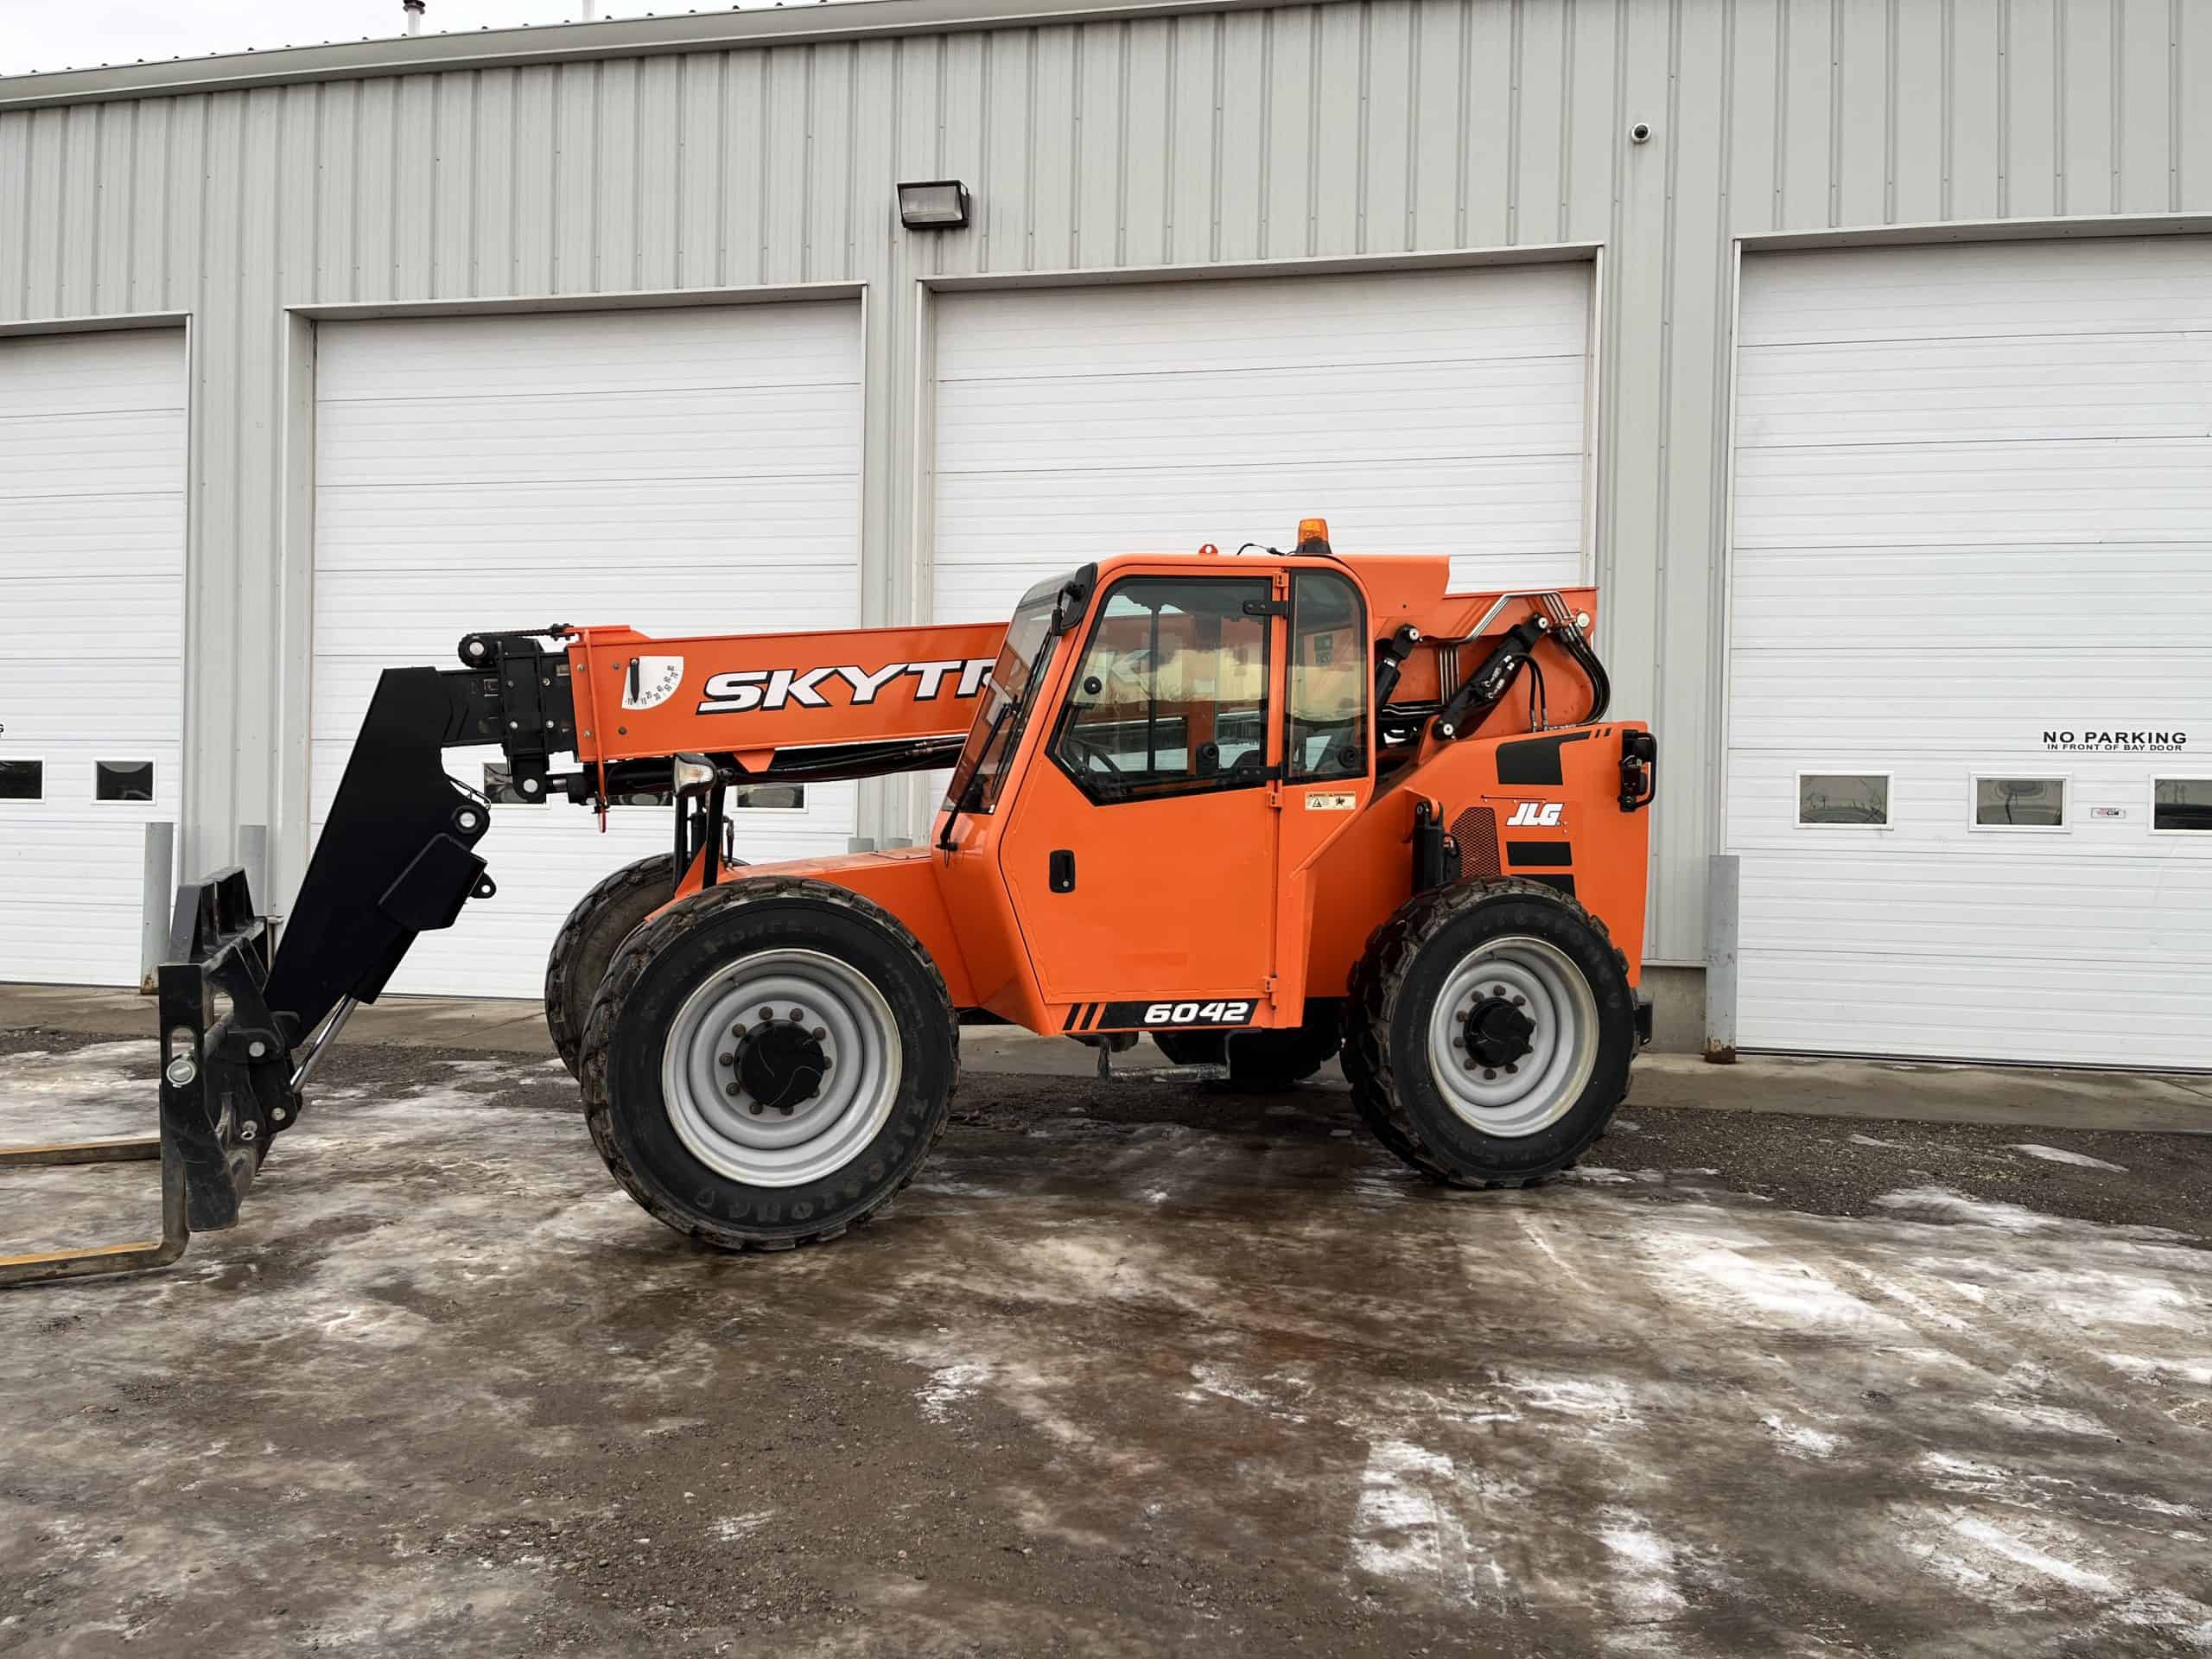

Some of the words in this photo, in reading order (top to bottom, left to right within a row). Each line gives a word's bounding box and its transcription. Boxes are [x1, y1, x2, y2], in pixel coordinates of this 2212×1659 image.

[2043, 731, 2075, 743] NO
[2085, 731, 2187, 744] PARKING
[1506, 802, 1564, 826] JLG
[1145, 1002, 1249, 1023] 6042
